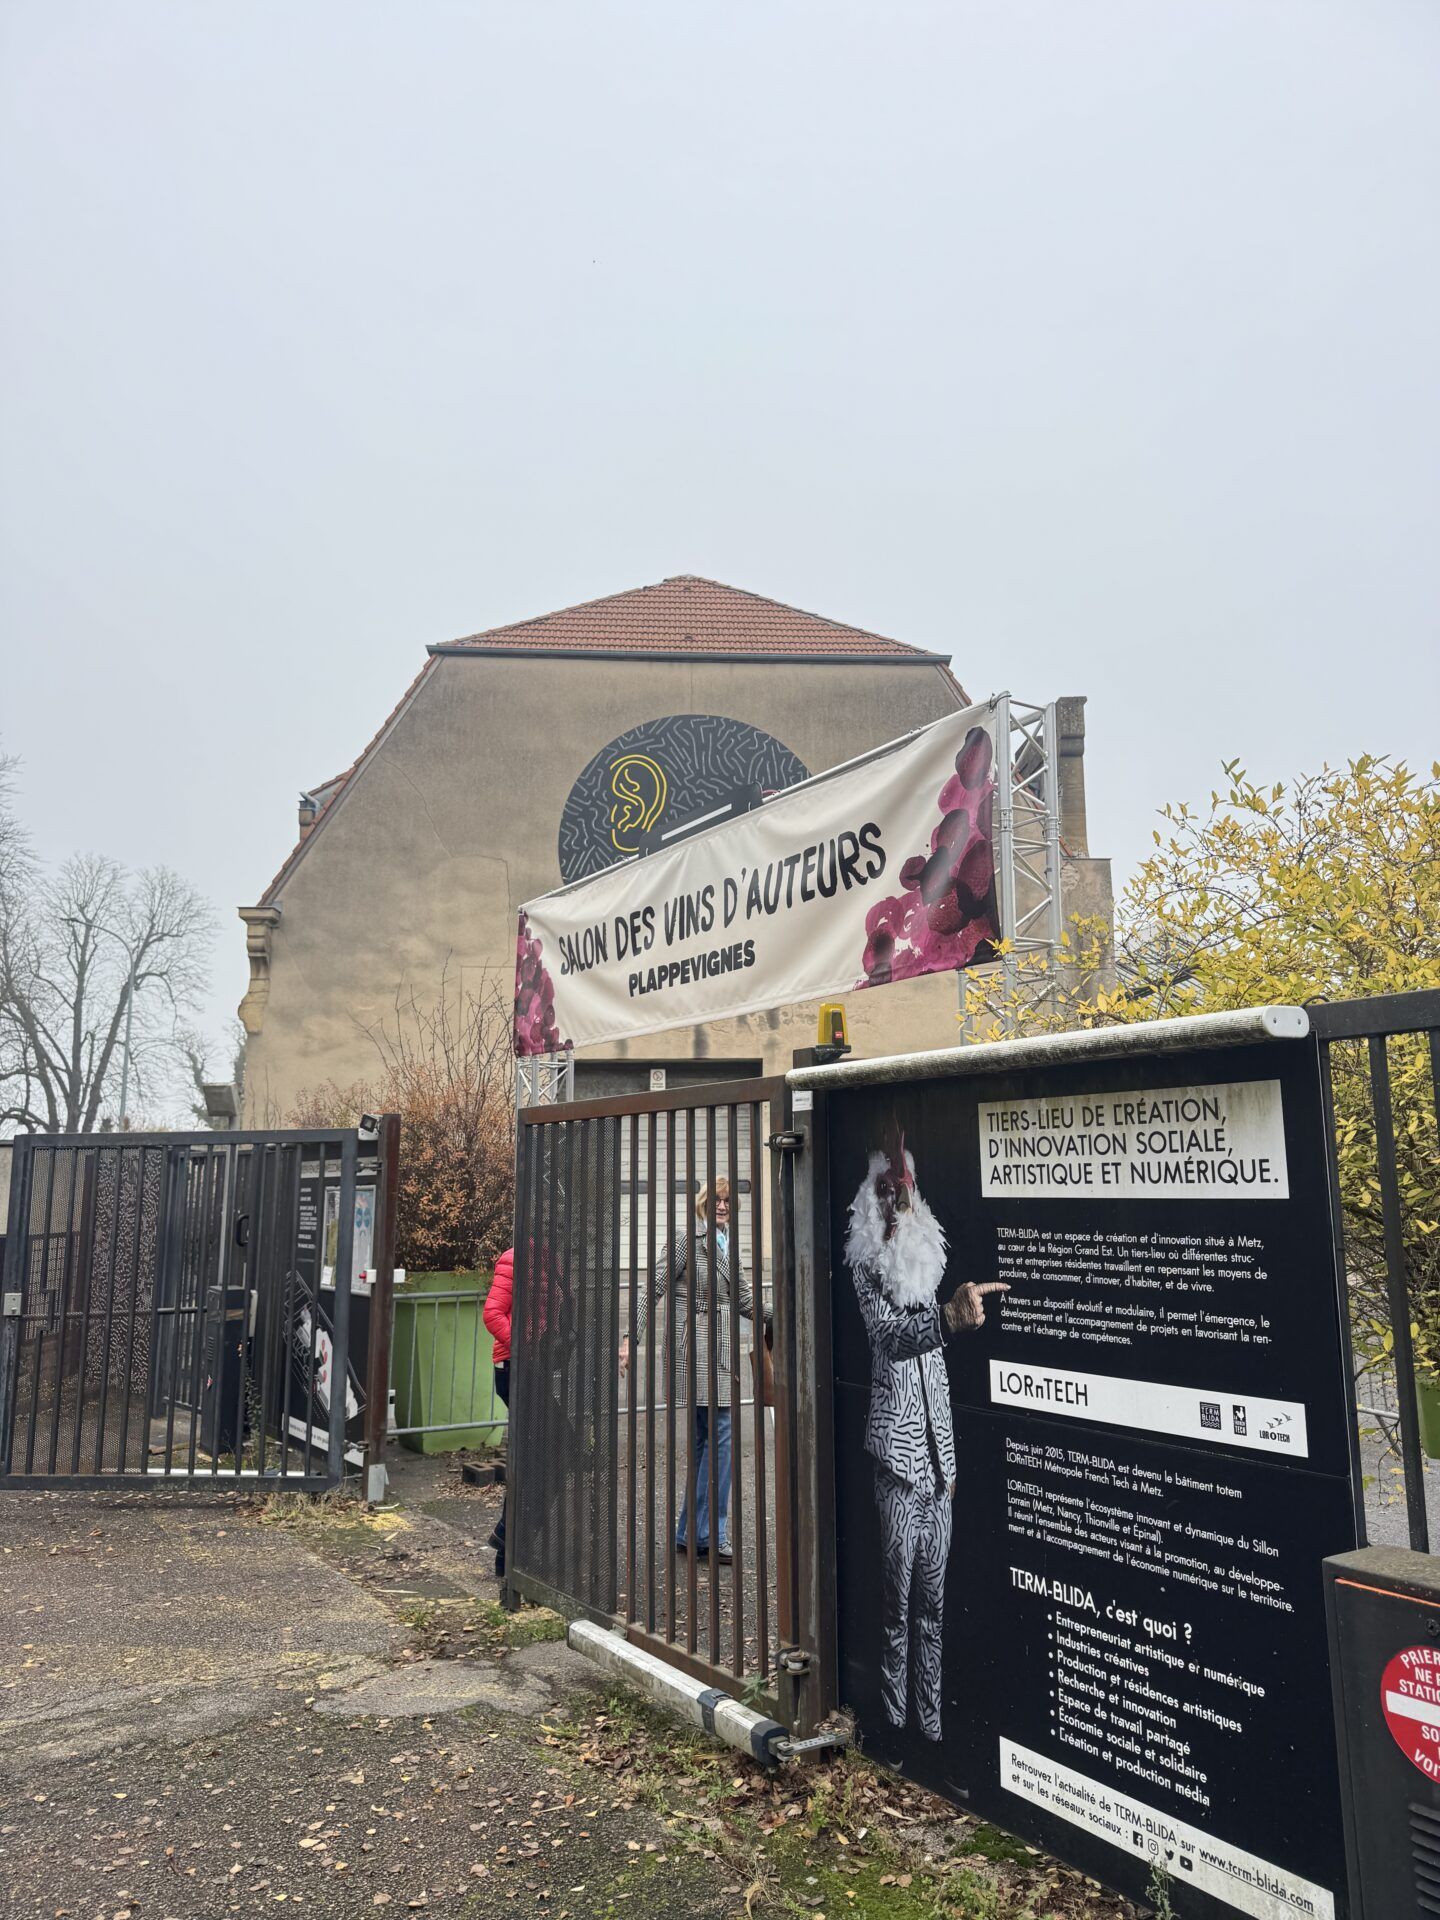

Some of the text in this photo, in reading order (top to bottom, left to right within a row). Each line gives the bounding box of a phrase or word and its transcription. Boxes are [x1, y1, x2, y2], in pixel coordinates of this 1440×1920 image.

[559, 822, 887, 975] SALON DES VINS D'AUTEURS
[629, 940, 756, 997] PLAPPEVIGNES
[987, 1098, 1231, 1132] TIERS-LIEU DE CRÉATION,
[989, 1129, 1232, 1158] D'INNOVATION SOCIALE,
[990, 1156, 1279, 1186] ARTISTIQUE ET NUMÉRIQUE.
[997, 1228, 1264, 1250] TCRM-BLIDA espace de création d'innovation situé Metz,
[1028, 1242, 1254, 1263] de Région Grand Est. Un tiers-lieu où différentes struc-
[999, 1267, 1214, 1292] produire, de consommer, d'innover, d'habiter, de vivre.
[1025, 1256, 1062, 1269] entreprises
[1065, 1258, 1101, 1270] résidentes
[1104, 1260, 1142, 1272] travaillent
[1158, 1267, 1200, 1276] repensant
[1203, 1264, 1214, 1276] les
[1218, 1270, 1251, 1280] moyens
[1255, 1268, 1267, 1279] de
[1001, 1306, 1053, 1321] développement
[1065, 1313, 1134, 1330] l'accompagnement
[1137, 1320, 1147, 1331] de
[1151, 1321, 1178, 1336] projets
[1195, 1325, 1238, 1340] favorisant
[1241, 1329, 1249, 1342] la
[1253, 1336, 1272, 1344] ren-
[1002, 1323, 1132, 1344] contre l'échange de compétences.
[1008, 1296, 1270, 1329] travers dispositif évolutif modulaire, permet l'émergence, le
[1006, 1438, 1242, 1498] Depuis juin 2015, TCRM-BLIDA est devenu le bâtiment totem
[1045, 1460, 1082, 1478] Métropole
[1085, 1469, 1109, 1484] French
[1112, 1475, 1129, 1489] Tech
[1141, 1482, 1163, 1496] Metz.
[1008, 1493, 1163, 1544] Lorrain (Metz, Nancy, Thionville Épinal).
[1046, 1492, 1083, 1507] représente
[1086, 1498, 1133, 1520] l'écosystème
[1137, 1512, 1170, 1529] innovant
[1185, 1523, 1234, 1545] dynamique
[1237, 1536, 1249, 1549] du
[1253, 1540, 1278, 1557] Sillon
[1009, 1524, 1294, 1612] ment l'accompagnement de l'économie numérique sur le territoire.
[1014, 1511, 1284, 1591] réunit l'ensemble des acteurs visant la promotion, au développe-
[1010, 1567, 1192, 1644] TCRM-BLIDA, c'est quoi ?
[1057, 1631, 1149, 1676] Industries créatives
[1057, 1611, 1265, 1697] Entrepreneuriat artistique numérique
[1414, 1666, 1432, 1684] NE
[1058, 1650, 1242, 1732] Production et résidences artistiques
[1058, 1670, 1176, 1728] Recherche et innovation
[1059, 1688, 1190, 1756] Espace de travail partagé
[1059, 1706, 1207, 1783] Économie sociale et solidaire
[1060, 1727, 1209, 1806] Création et production média
[1414, 1748, 1440, 1776] VOI
[1012, 1753, 1313, 1912] Retrouvez l'actualité de TCRM-BLIDA sur www.tcrm-blida.com
[1023, 1780, 1121, 1836] sur les réseaux sociaux
